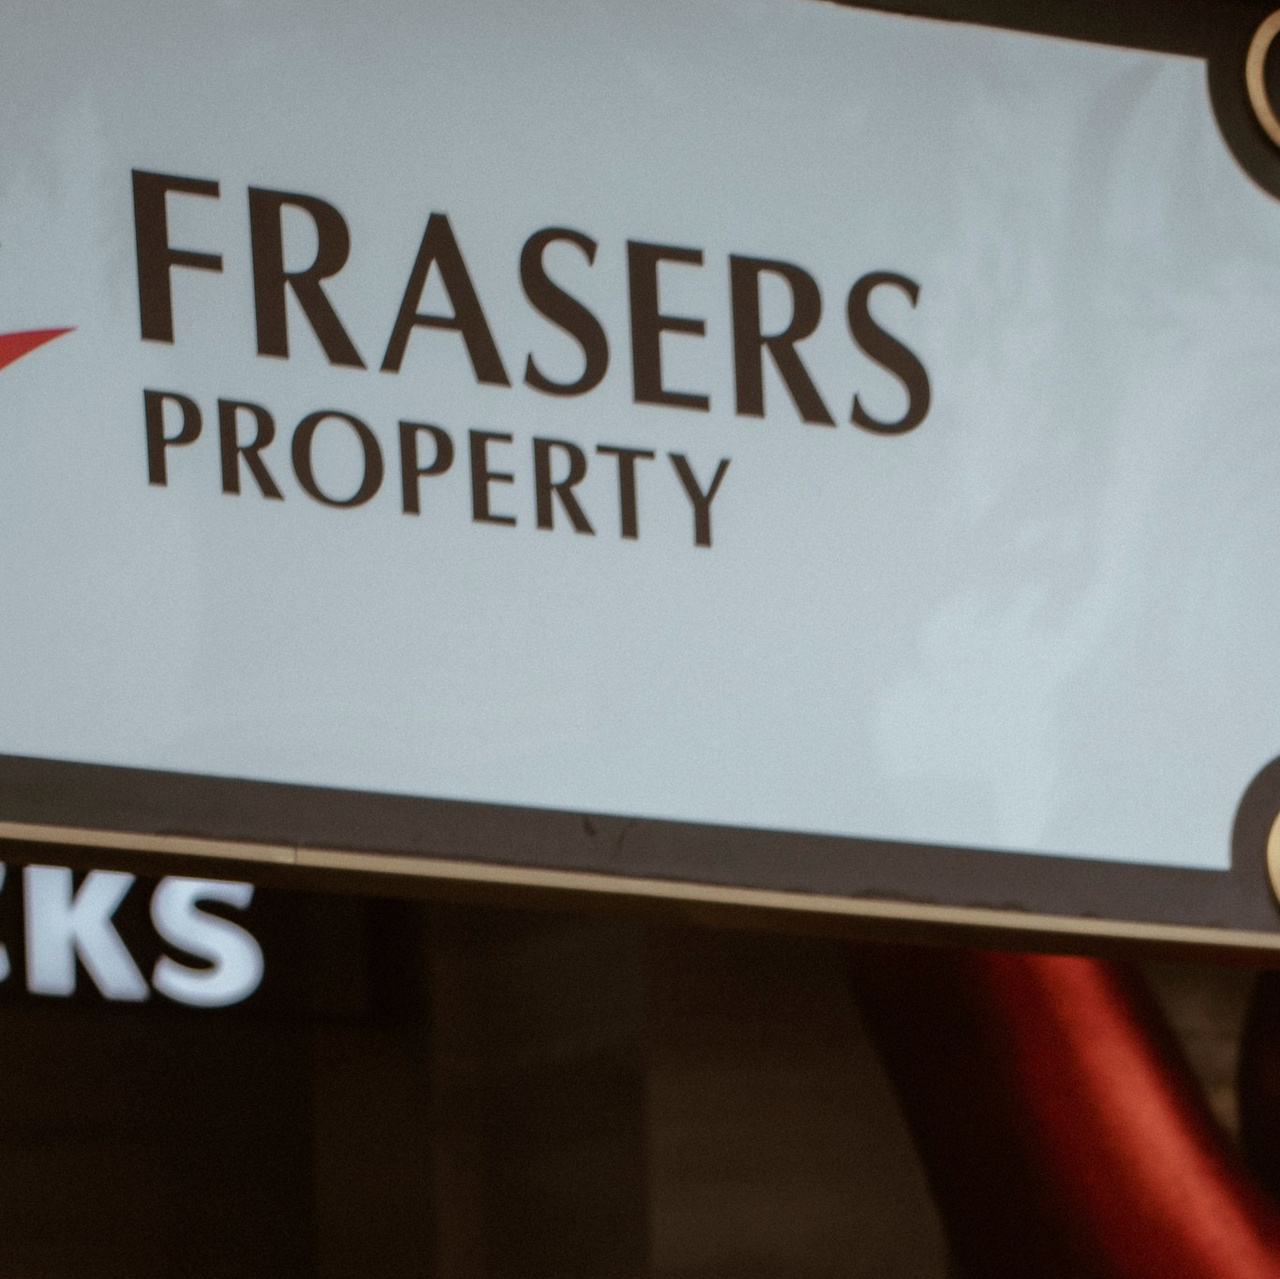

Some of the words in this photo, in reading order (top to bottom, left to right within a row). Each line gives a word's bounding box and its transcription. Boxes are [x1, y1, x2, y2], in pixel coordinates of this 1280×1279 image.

[130, 167, 933, 437] FRASERS
[142, 387, 732, 549] PROPERTY
[0, 860, 265, 1009] KS
